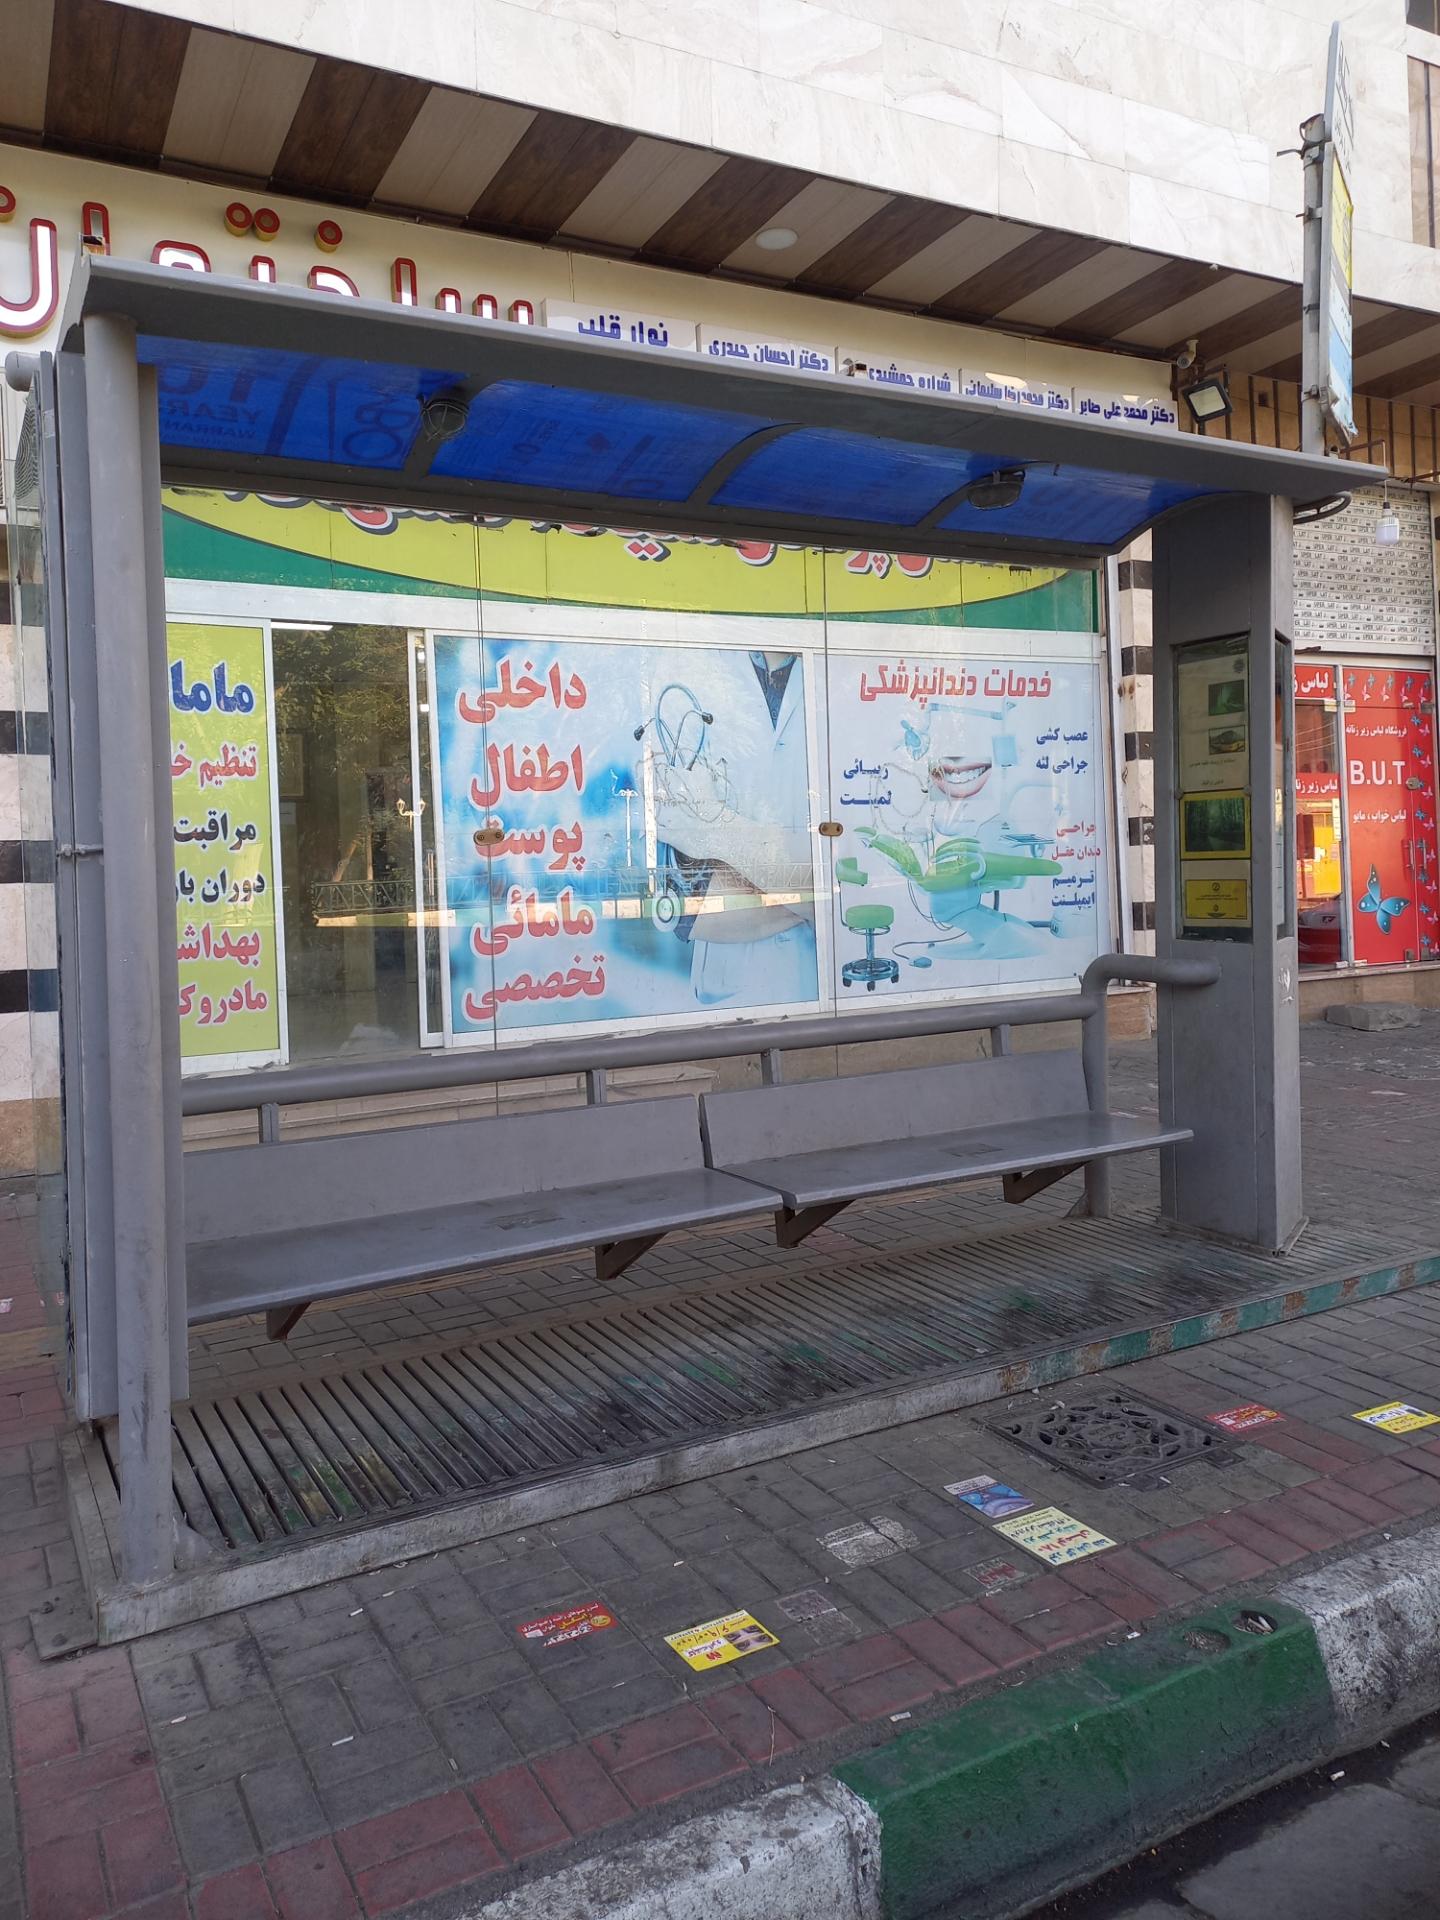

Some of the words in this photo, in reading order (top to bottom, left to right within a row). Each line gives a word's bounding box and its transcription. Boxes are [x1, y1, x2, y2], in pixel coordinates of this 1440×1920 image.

[631, 322, 668, 347] نوار
[753, 344, 795, 366] احسان
[799, 349, 829, 371] دکتر
[1047, 390, 1070, 410] دکتر
[1123, 406, 1148, 420] محمد
[1150, 405, 1175, 426] دکتر
[457, 659, 588, 724] داخلی
[859, 658, 978, 710] دندانپزشکی
[983, 668, 1052, 698] خدمات
[1300, 671, 1330, 693] لباس
[1036, 727, 1061, 745] کشی
[1062, 731, 1089, 745] عصب
[199, 743, 256, 788] تنظیم
[470, 742, 585, 808] اطفال
[1052, 755, 1089, 774] جراحی
[1307, 780, 1320, 793] زیر
[1319, 778, 1339, 793] لباس
[173, 810, 257, 851] مراقبت
[474, 815, 586, 872] پوست
[1076, 845, 1102, 860] دندان
[201, 868, 265, 903] دوران
[1052, 869, 1095, 889] ترمیم
[177, 922, 260, 967] بهداش
[464, 953, 606, 1021] تخصصی
[212, 980, 268, 1024] مادر
